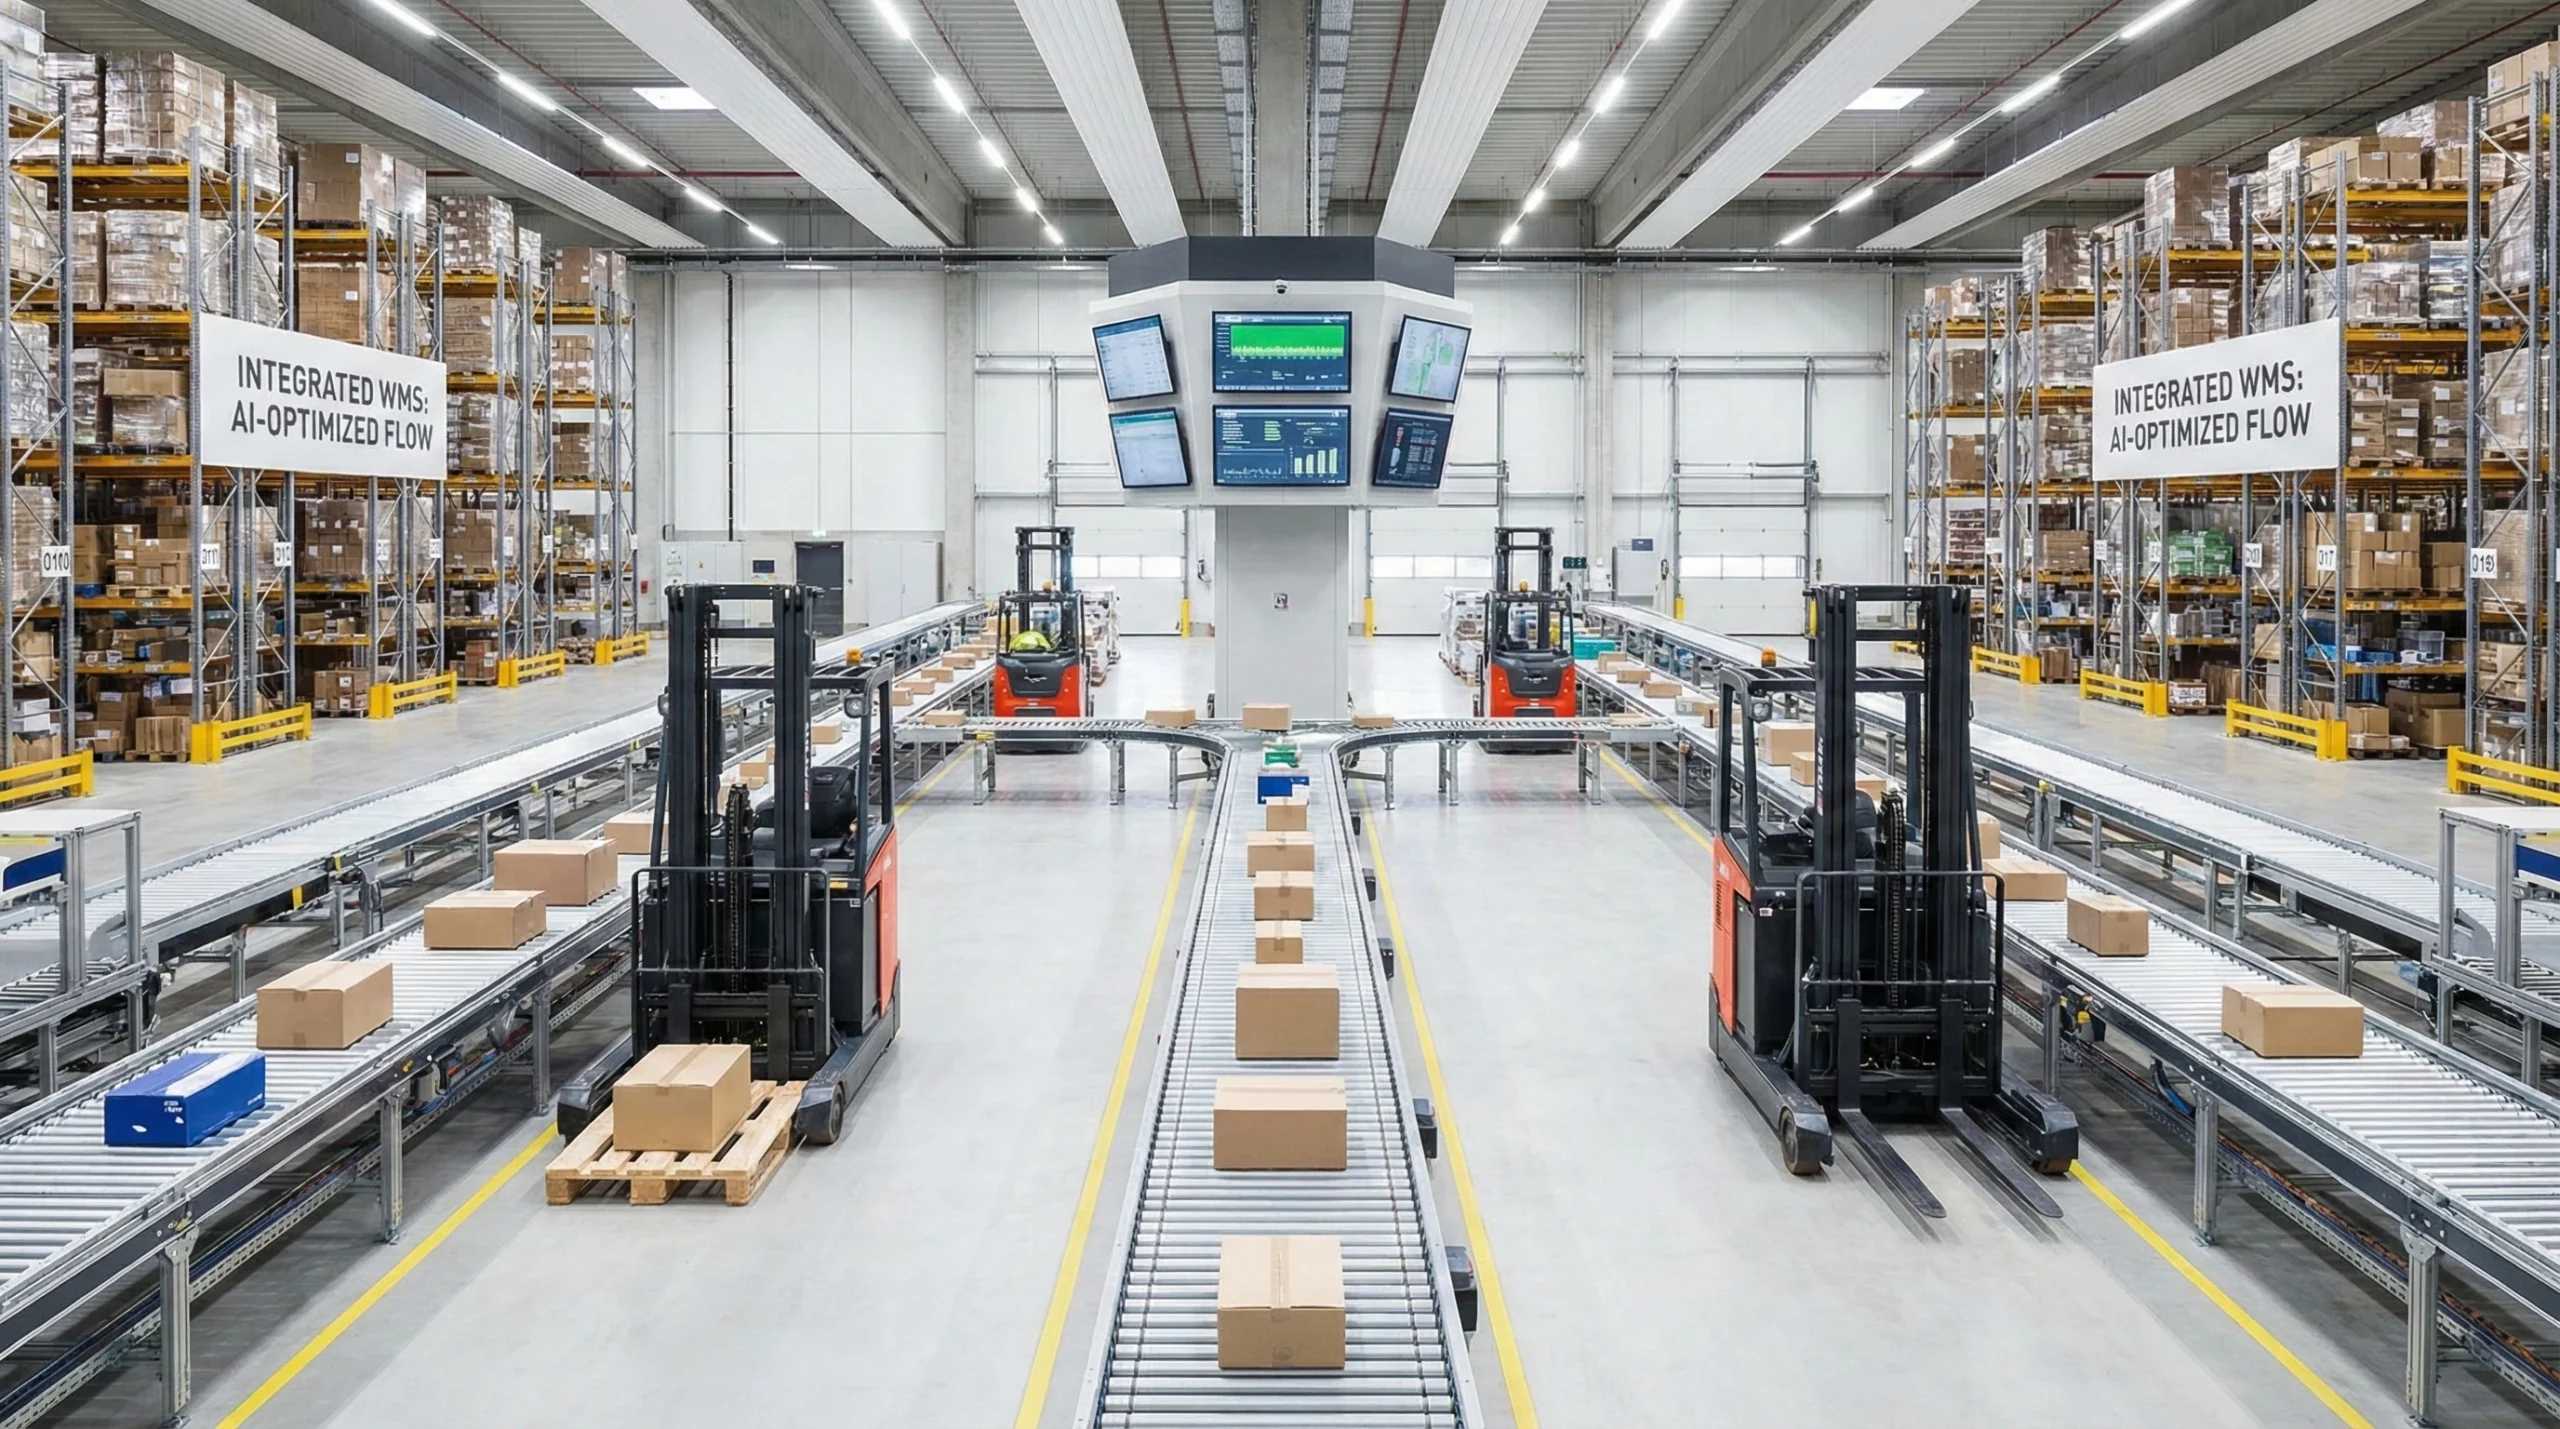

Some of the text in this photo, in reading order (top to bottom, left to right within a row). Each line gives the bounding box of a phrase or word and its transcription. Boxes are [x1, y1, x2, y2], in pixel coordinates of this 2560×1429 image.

[238, 354, 428, 414] INTEGRATED WMS:
[2114, 360, 2303, 416] INTEGRATED WMS:
[231, 399, 433, 451] AI-OPTIMIZED FLOW
[2109, 402, 2312, 453] AI-OPTIMIZED FLOW
